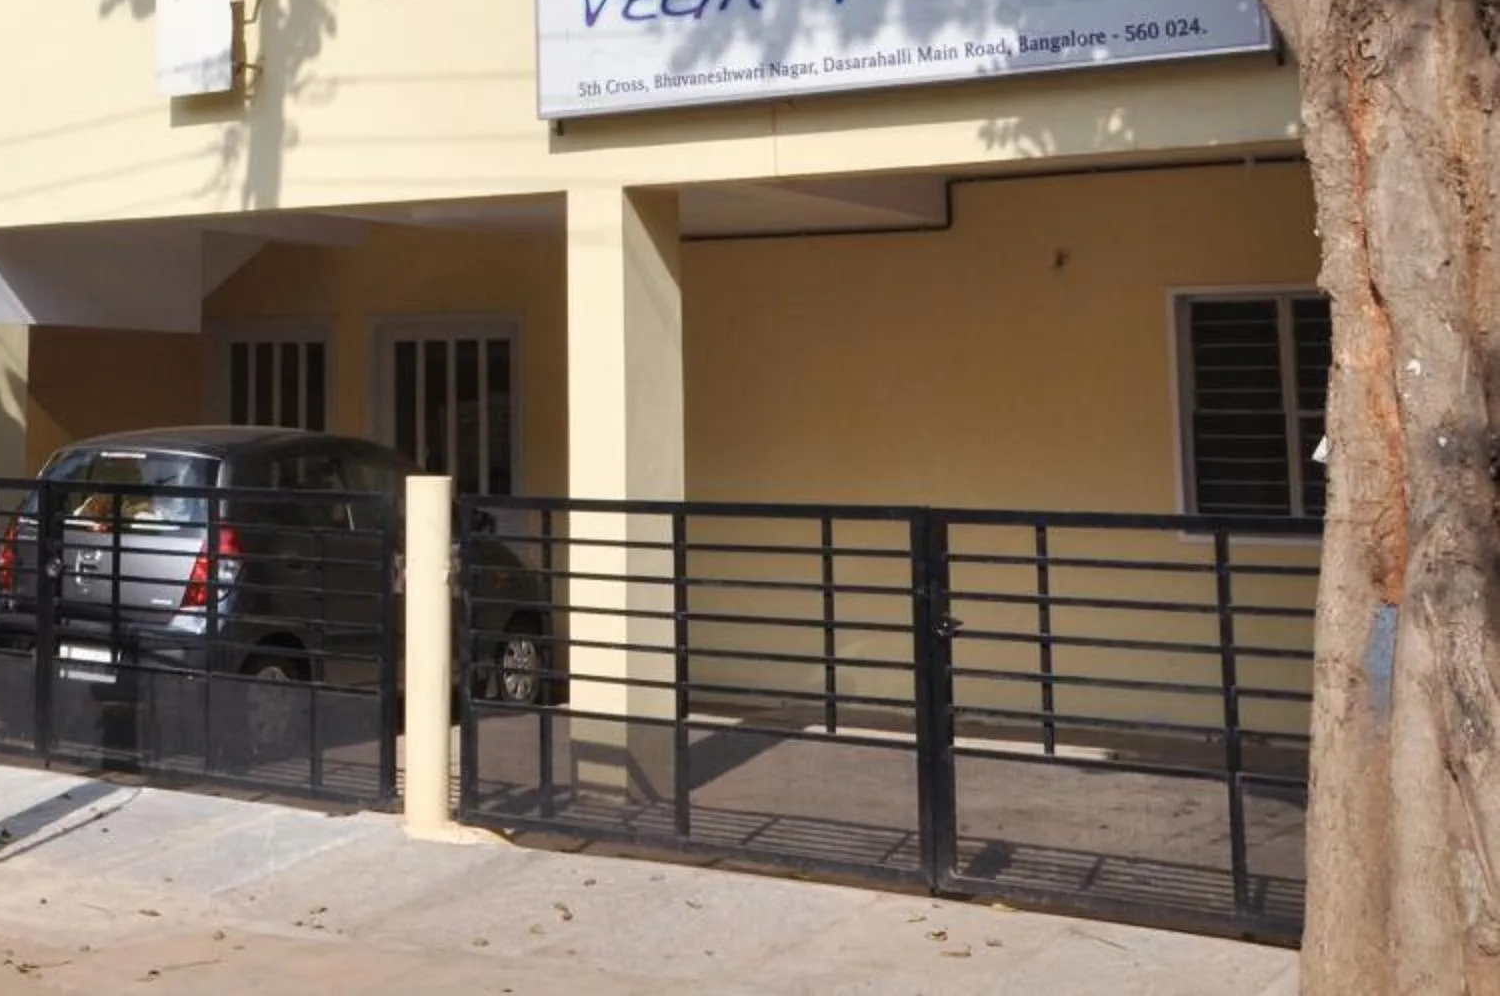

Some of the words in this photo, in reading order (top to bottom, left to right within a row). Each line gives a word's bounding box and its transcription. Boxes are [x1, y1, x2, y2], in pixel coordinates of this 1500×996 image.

[579, 79, 602, 98] 5th
[605, 77, 649, 95] Cross,
[654, 63, 766, 89] Bhuvaneshwari
[768, 60, 819, 79] Nagar,
[823, 49, 912, 73] Dasarahalli
[917, 44, 958, 63] Main
[964, 37, 1012, 59] Road,
[1018, 29, 1107, 53] Bangalore
[1125, 22, 1160, 42] 560
[1165, 17, 1209, 38] 024.
